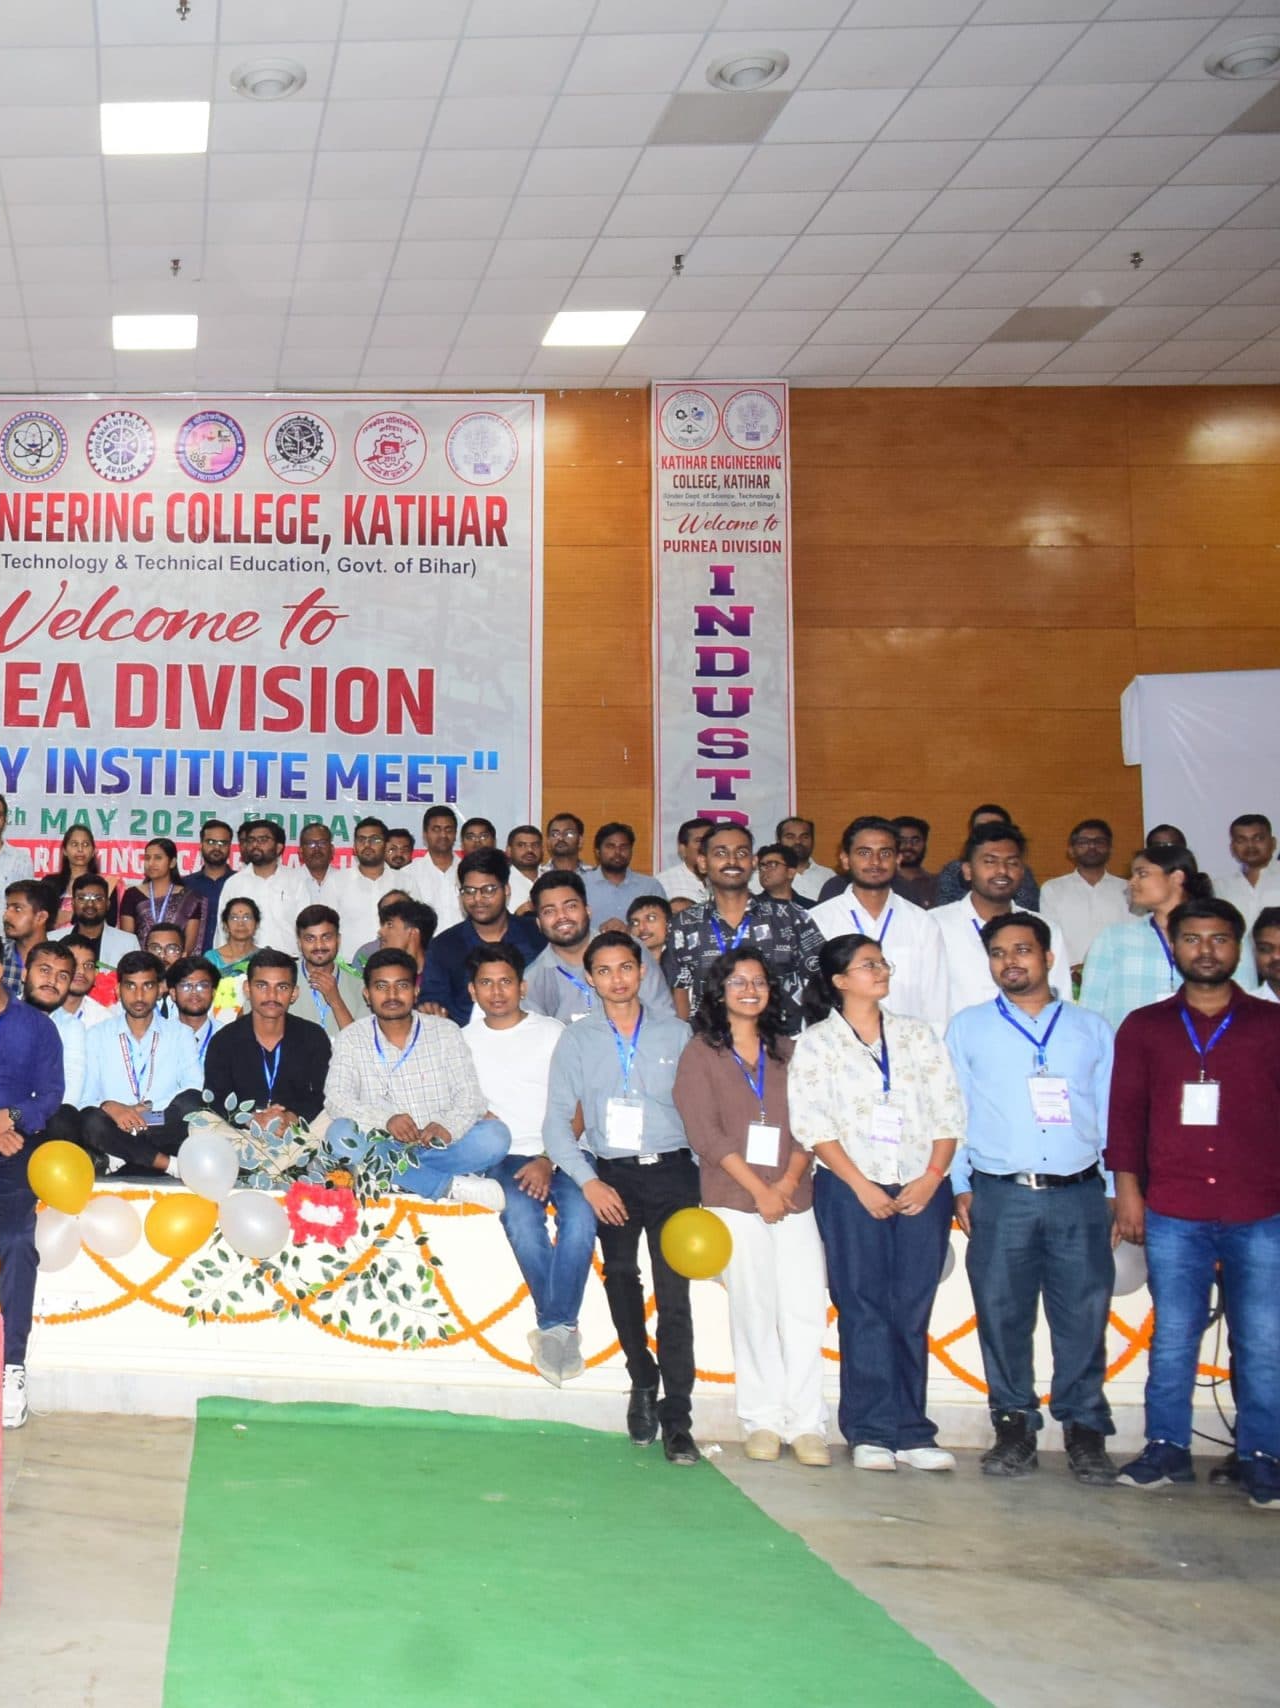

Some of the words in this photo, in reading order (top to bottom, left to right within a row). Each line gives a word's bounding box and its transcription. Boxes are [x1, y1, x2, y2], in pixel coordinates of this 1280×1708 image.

[661, 455, 707, 469] KATIHAR
[711, 455, 782, 470] ENGINEERING
[672, 474, 721, 491] COLLEGE,
[723, 474, 771, 489] KATIHAR
[165, 492, 332, 554] COLLEGE,
[344, 494, 509, 547] KATIHAR
[663, 512, 759, 534] Welcome
[762, 513, 782, 533] to
[663, 540, 718, 553] PURNEA
[722, 540, 782, 553] DIVISION
[2, 554, 109, 574] Technology
[115, 555, 129, 570] &
[136, 554, 223, 571] Technical
[230, 555, 330, 575] Education,
[337, 557, 387, 573] Govt.
[394, 556, 413, 573] of
[419, 557, 477, 578] Bihar)
[278, 587, 350, 650] to
[114, 662, 435, 736] DIVISION
[45, 746, 308, 801] INSTITUTE
[325, 750, 499, 804] MEET"
[40, 807, 118, 836] MAY
